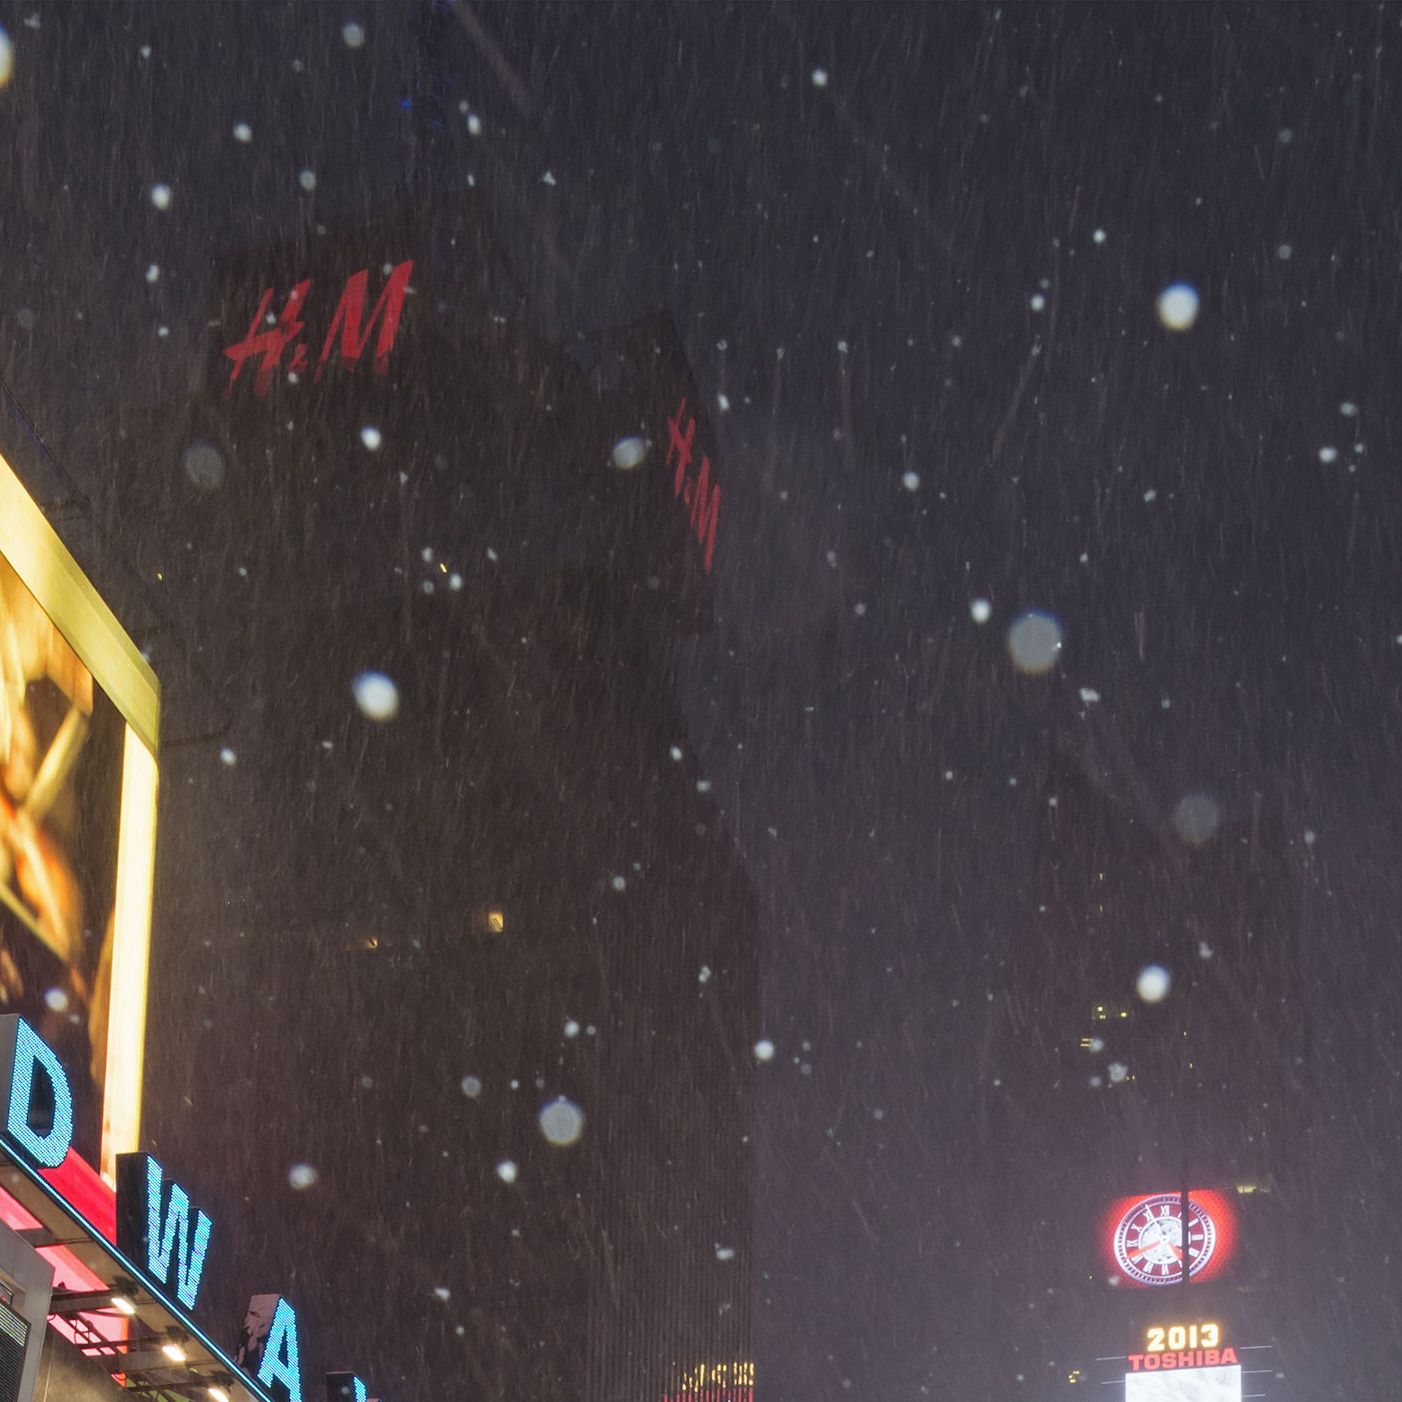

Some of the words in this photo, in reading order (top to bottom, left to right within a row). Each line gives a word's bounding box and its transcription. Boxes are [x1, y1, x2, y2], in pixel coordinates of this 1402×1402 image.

[222, 259, 414, 398] H&M
[665, 397, 721, 574] H&M
[1128, 1347, 1238, 1372] TOSHIBA
[1147, 1322, 1220, 1353] 2013
